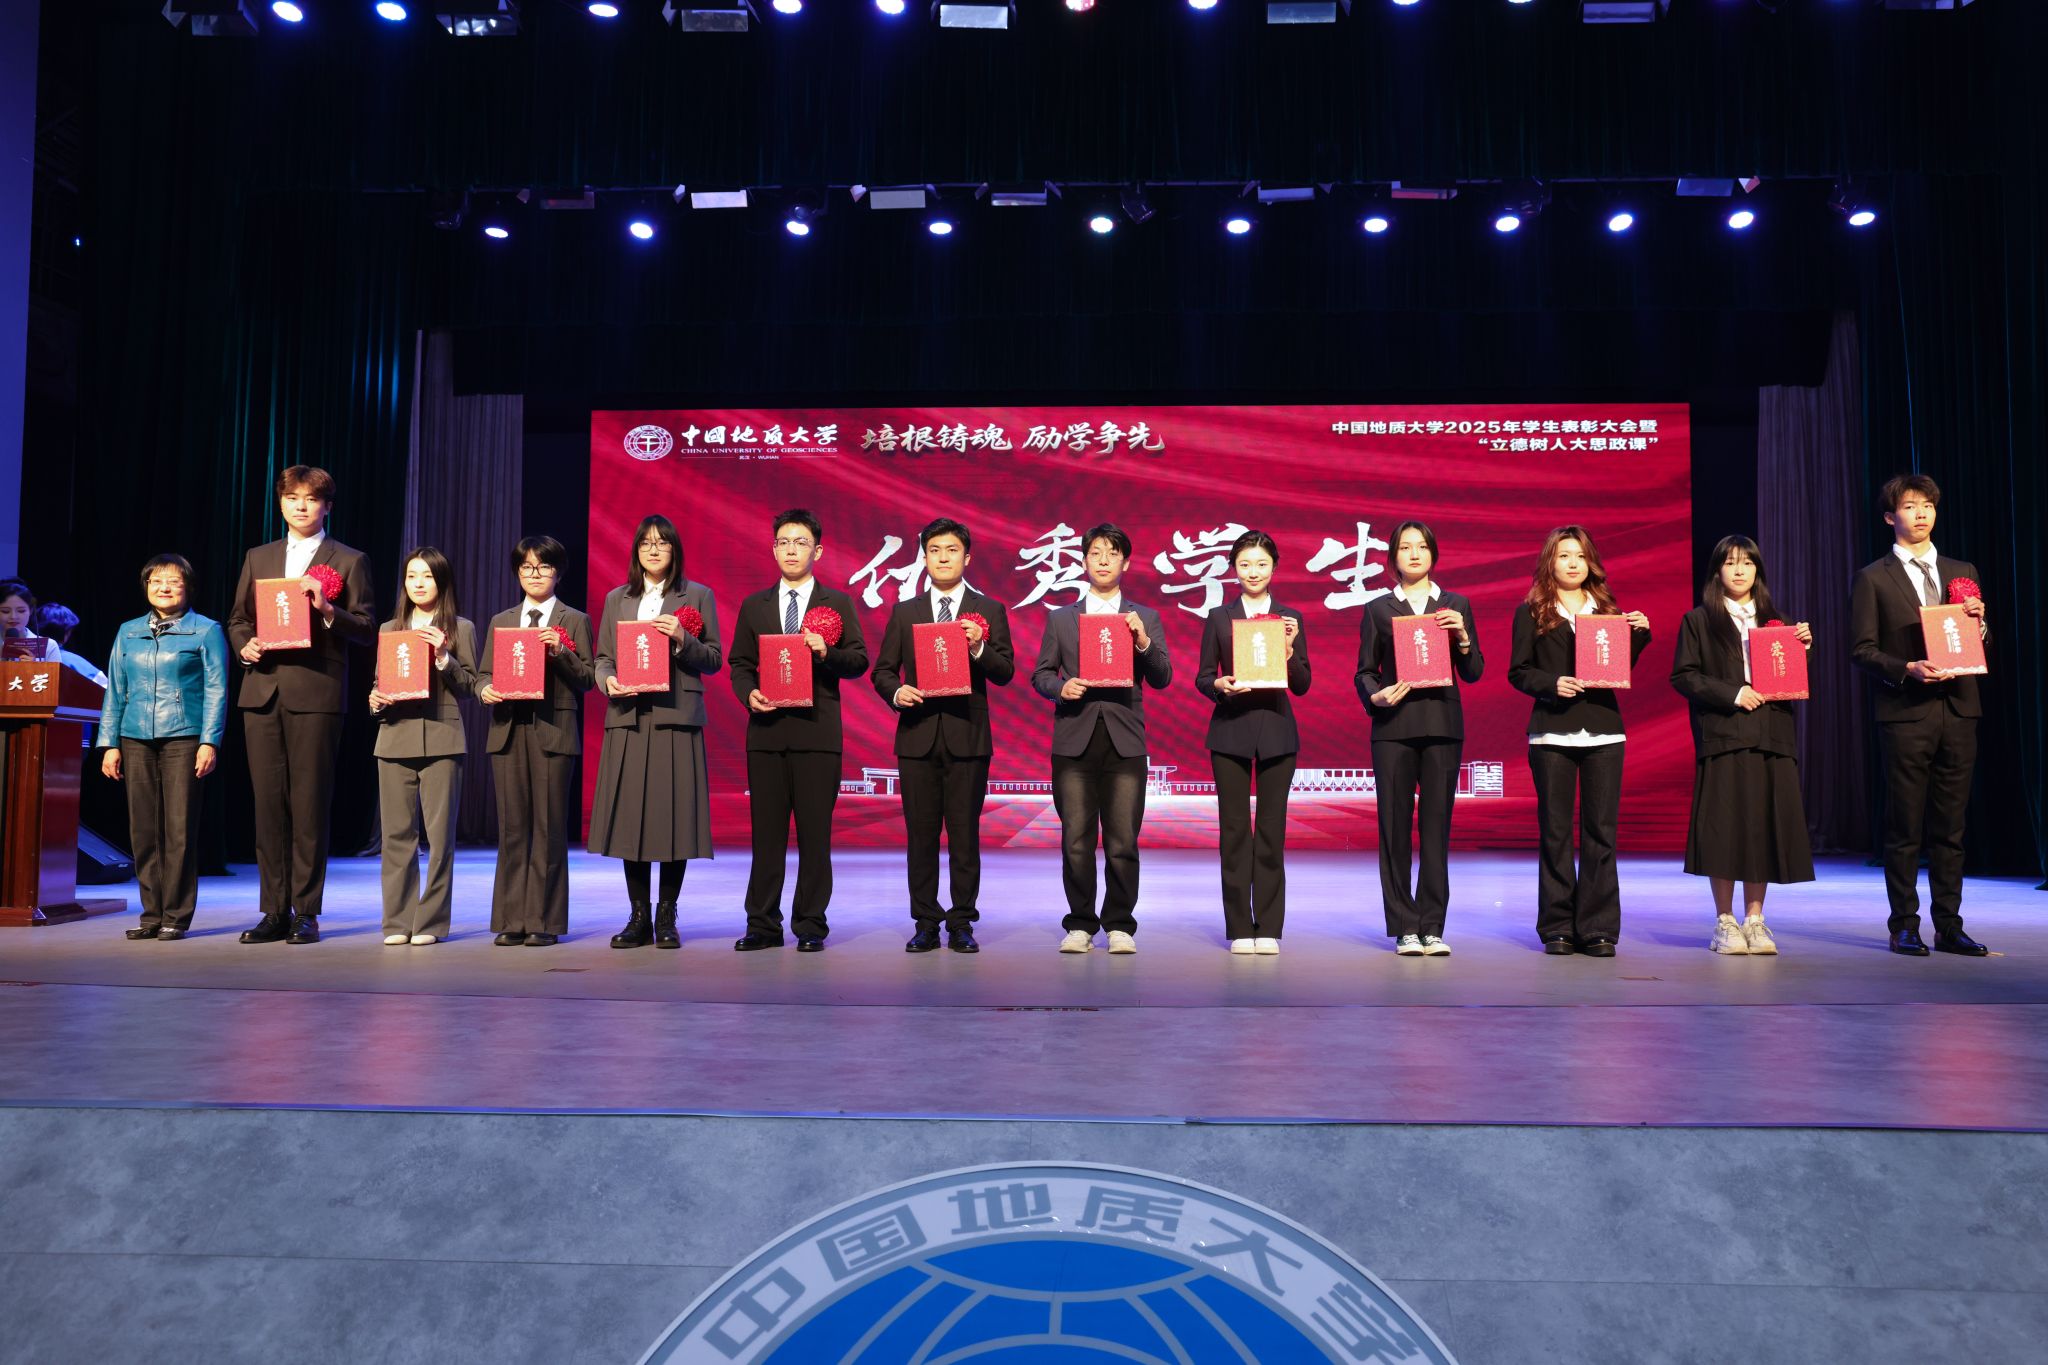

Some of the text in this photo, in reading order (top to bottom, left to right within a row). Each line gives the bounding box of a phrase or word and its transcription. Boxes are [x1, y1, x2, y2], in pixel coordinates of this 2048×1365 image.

[1331, 419, 1658, 435] 中国地质大学2025年学生表彰大会暨
[861, 421, 1166, 454] 培根铸魂 励学争先
[1478, 436, 1659, 451] “立德树人大思政课”
[8, 673, 49, 692] 大学
[702, 1183, 1420, 1365] 中国地质大学
